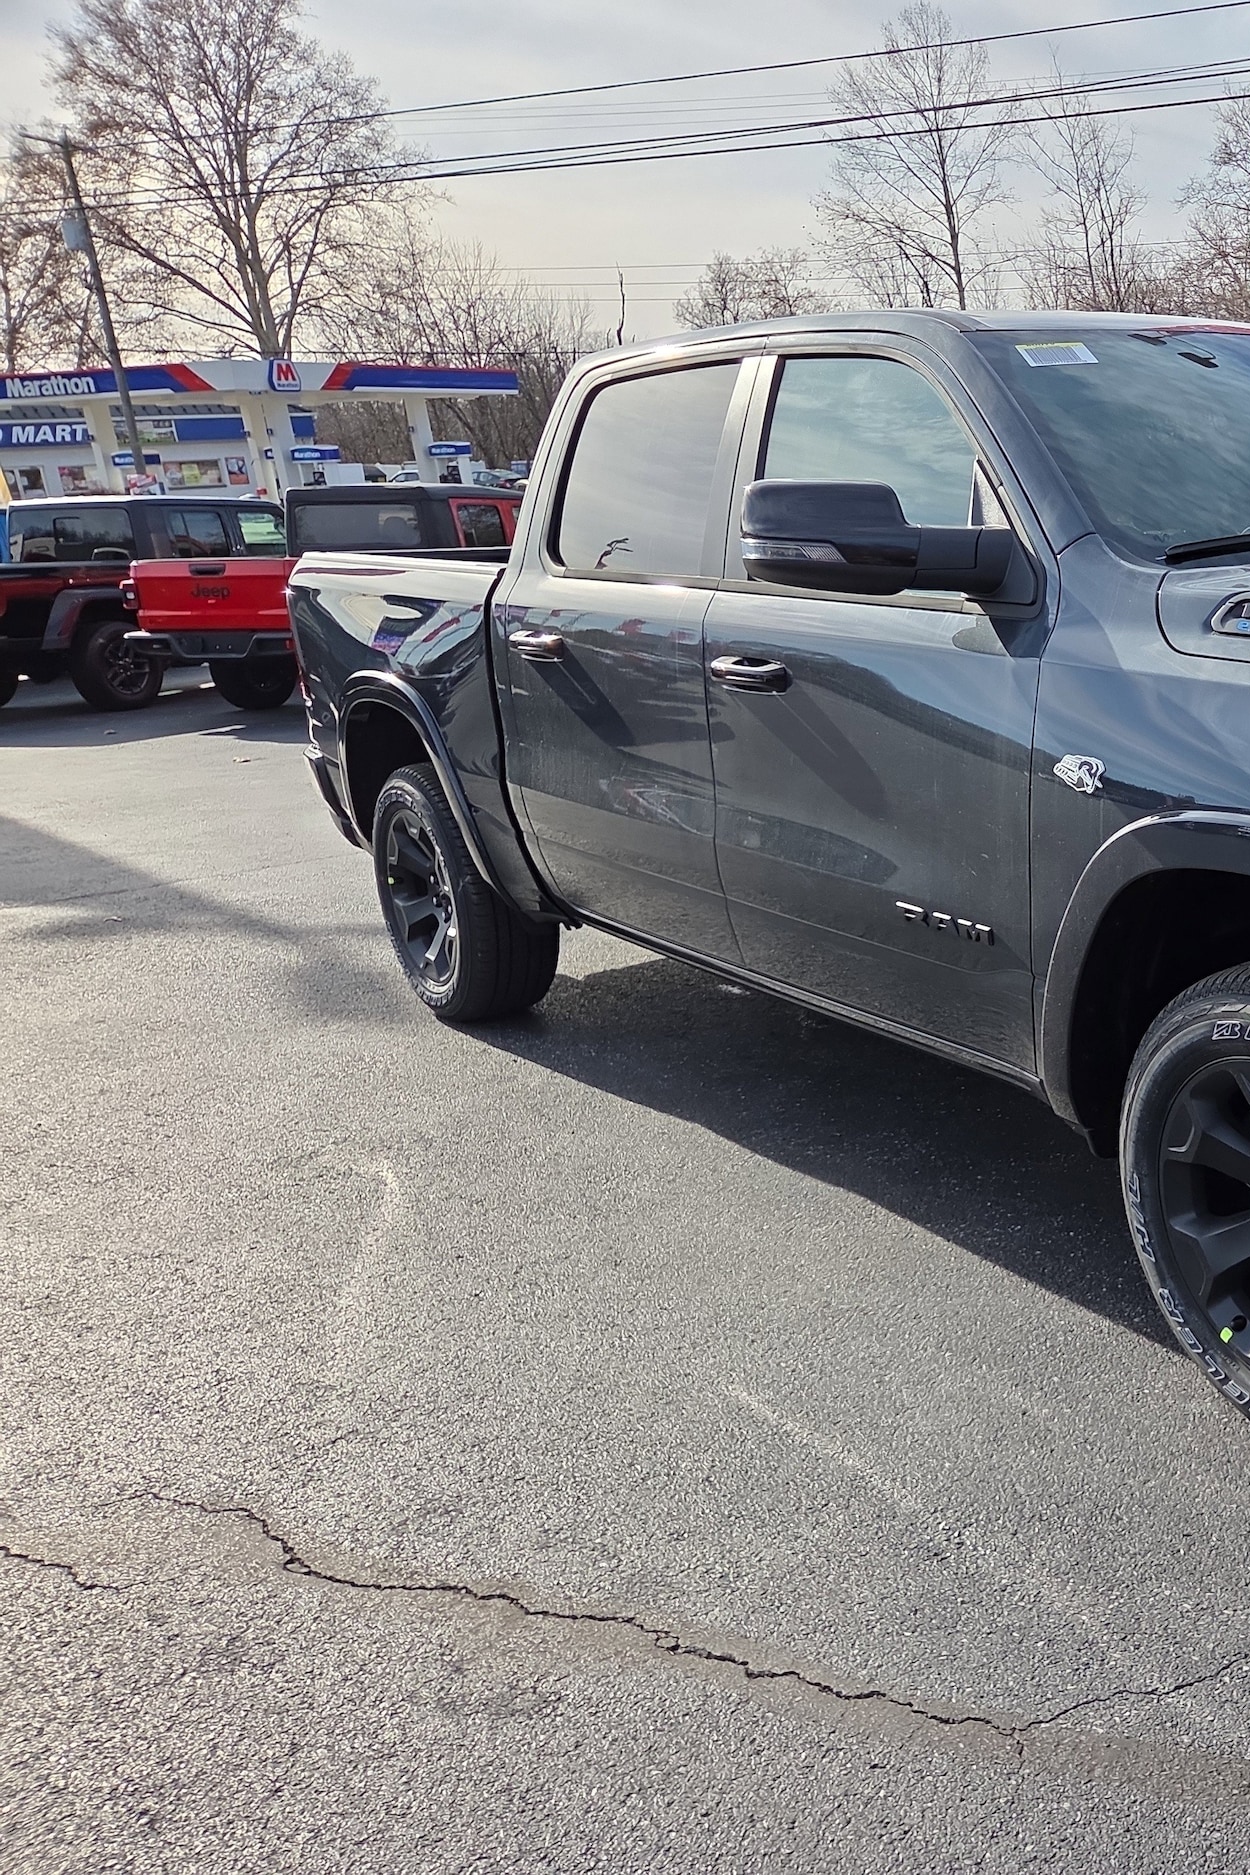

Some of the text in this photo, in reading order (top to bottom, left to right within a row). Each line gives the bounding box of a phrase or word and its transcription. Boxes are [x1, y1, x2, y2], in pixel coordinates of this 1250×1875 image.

[5, 375, 96, 398] Marathon
[11, 424, 87, 443] MART
[191, 584, 230, 599] Jeep
[895, 900, 995, 946] RAM
